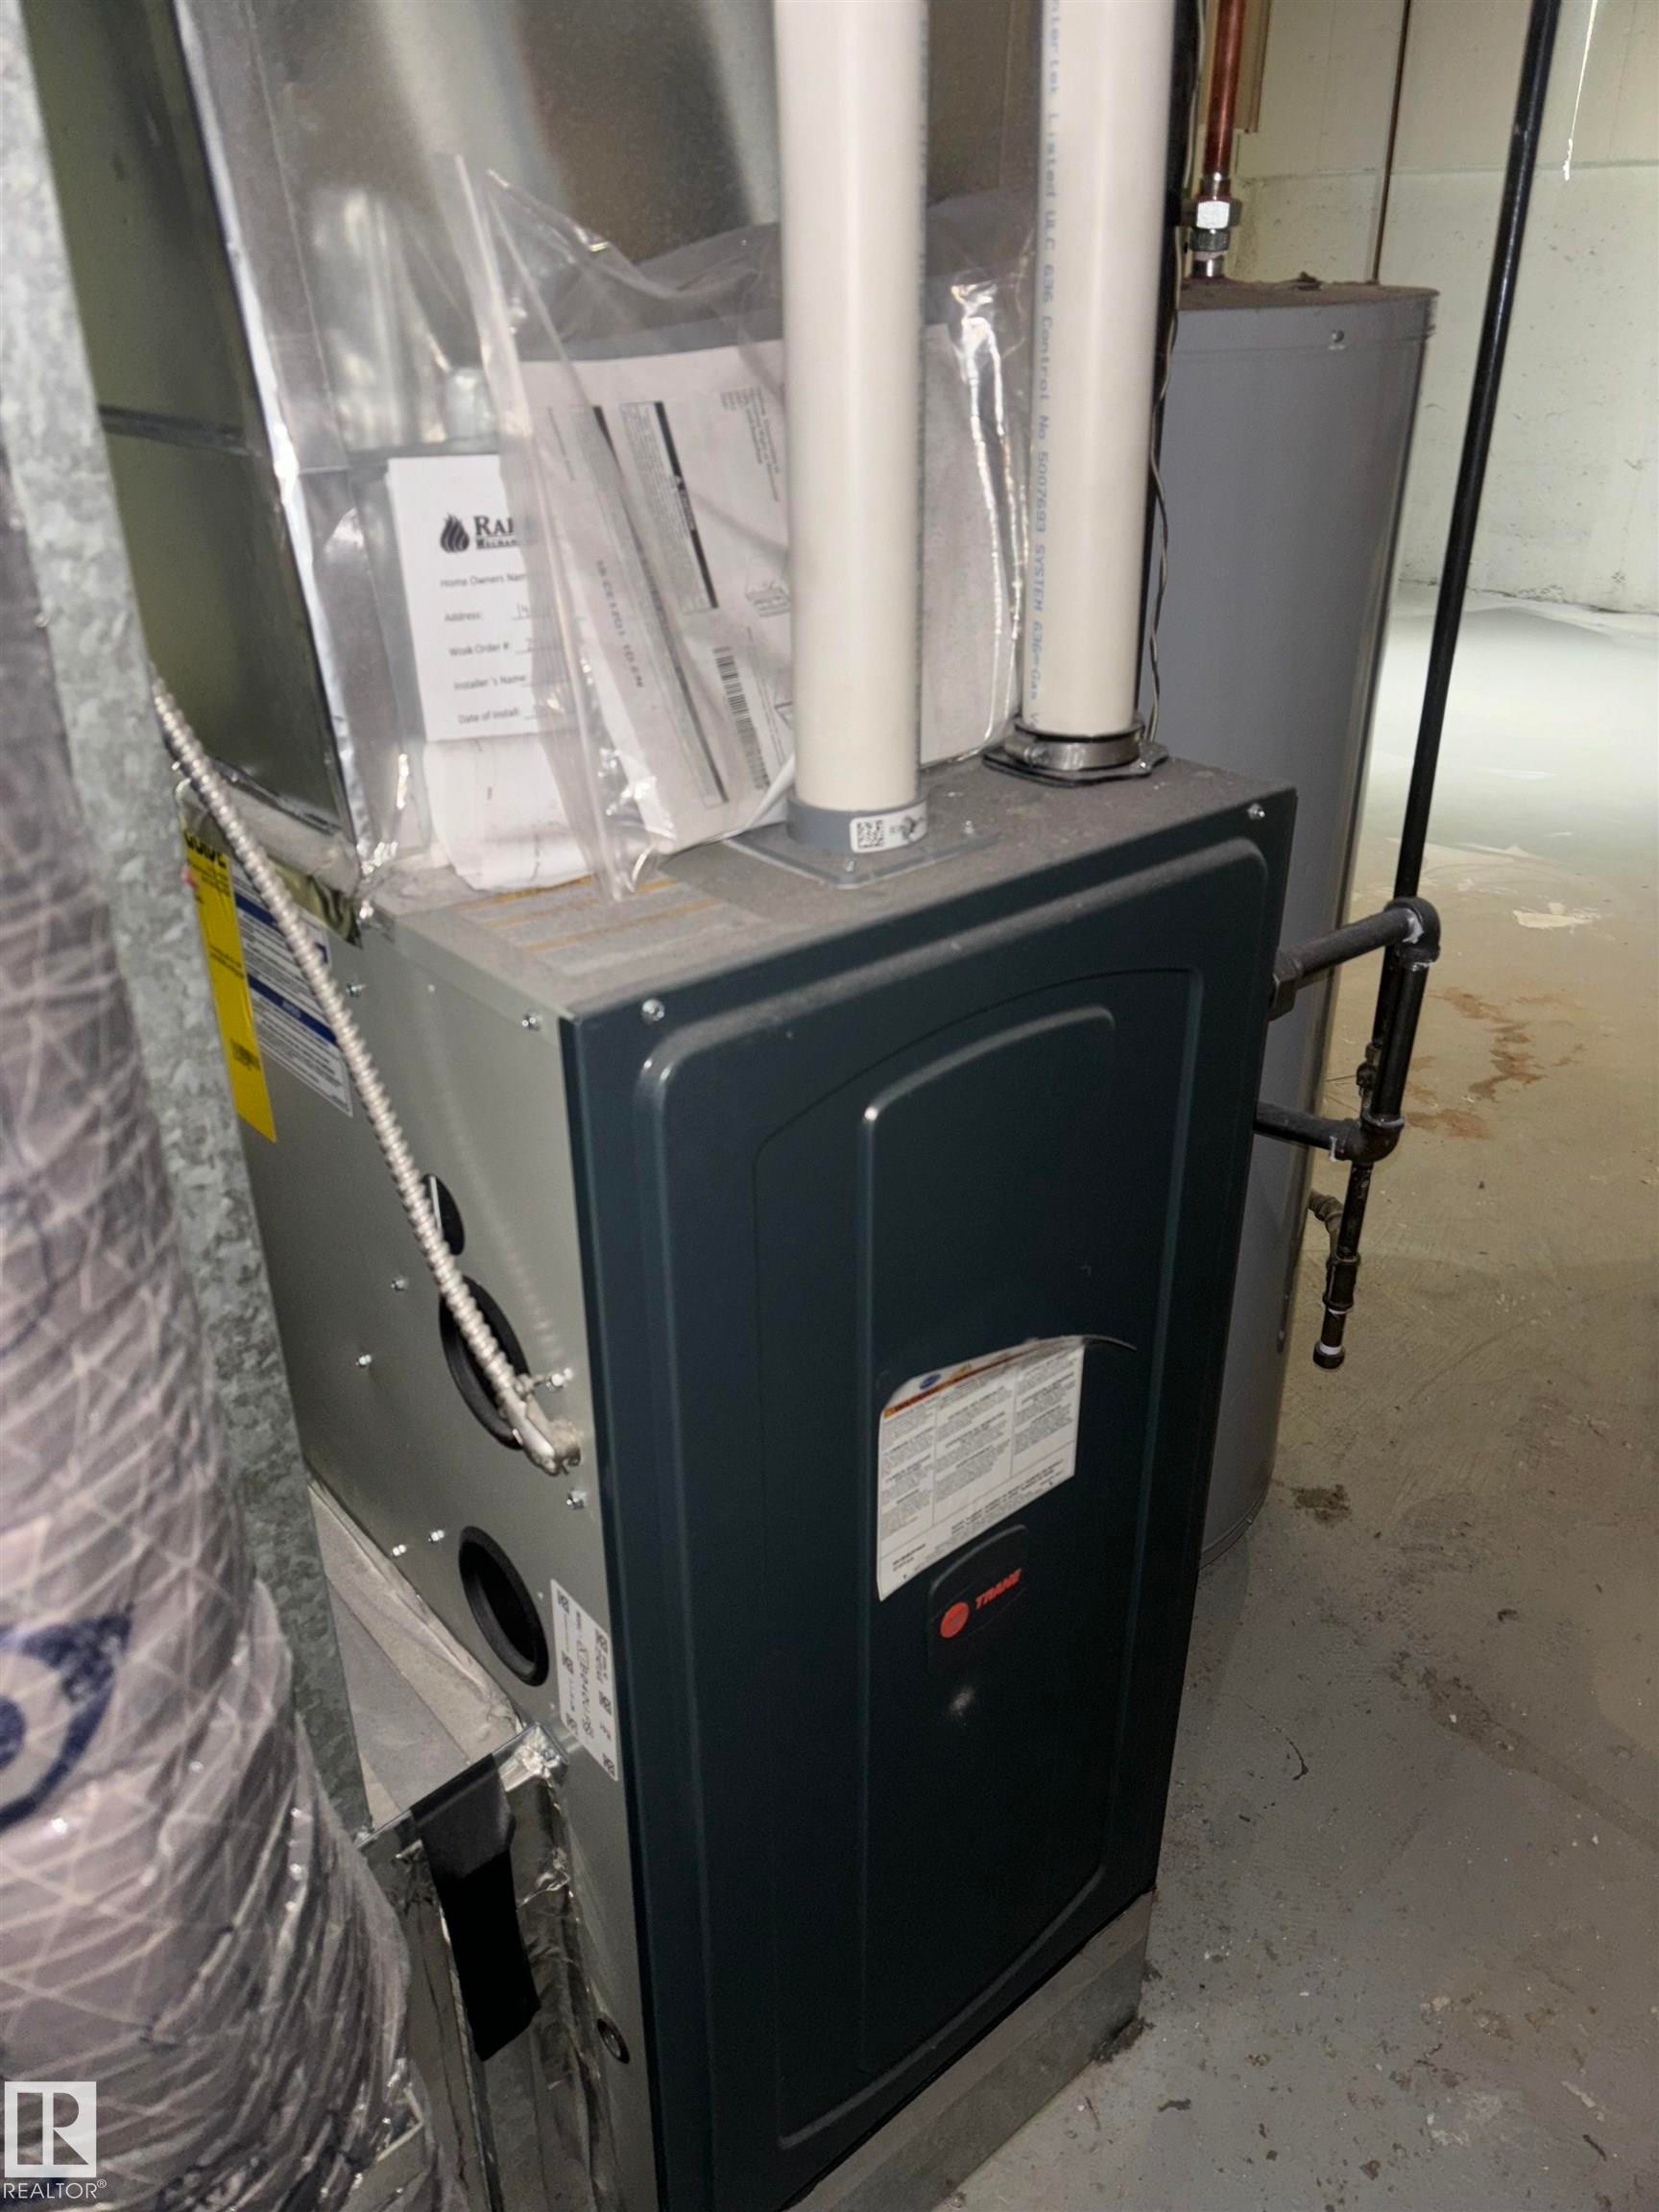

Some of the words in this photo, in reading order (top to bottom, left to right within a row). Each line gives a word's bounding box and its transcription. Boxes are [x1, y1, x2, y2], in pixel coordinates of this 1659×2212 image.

[1044, 209, 1057, 252] ULC
[1042, 264, 1055, 303] 636
[1038, 314, 1054, 400] Control
[1037, 414, 1050, 441] No
[1033, 543, 1046, 613] SYSTEM
